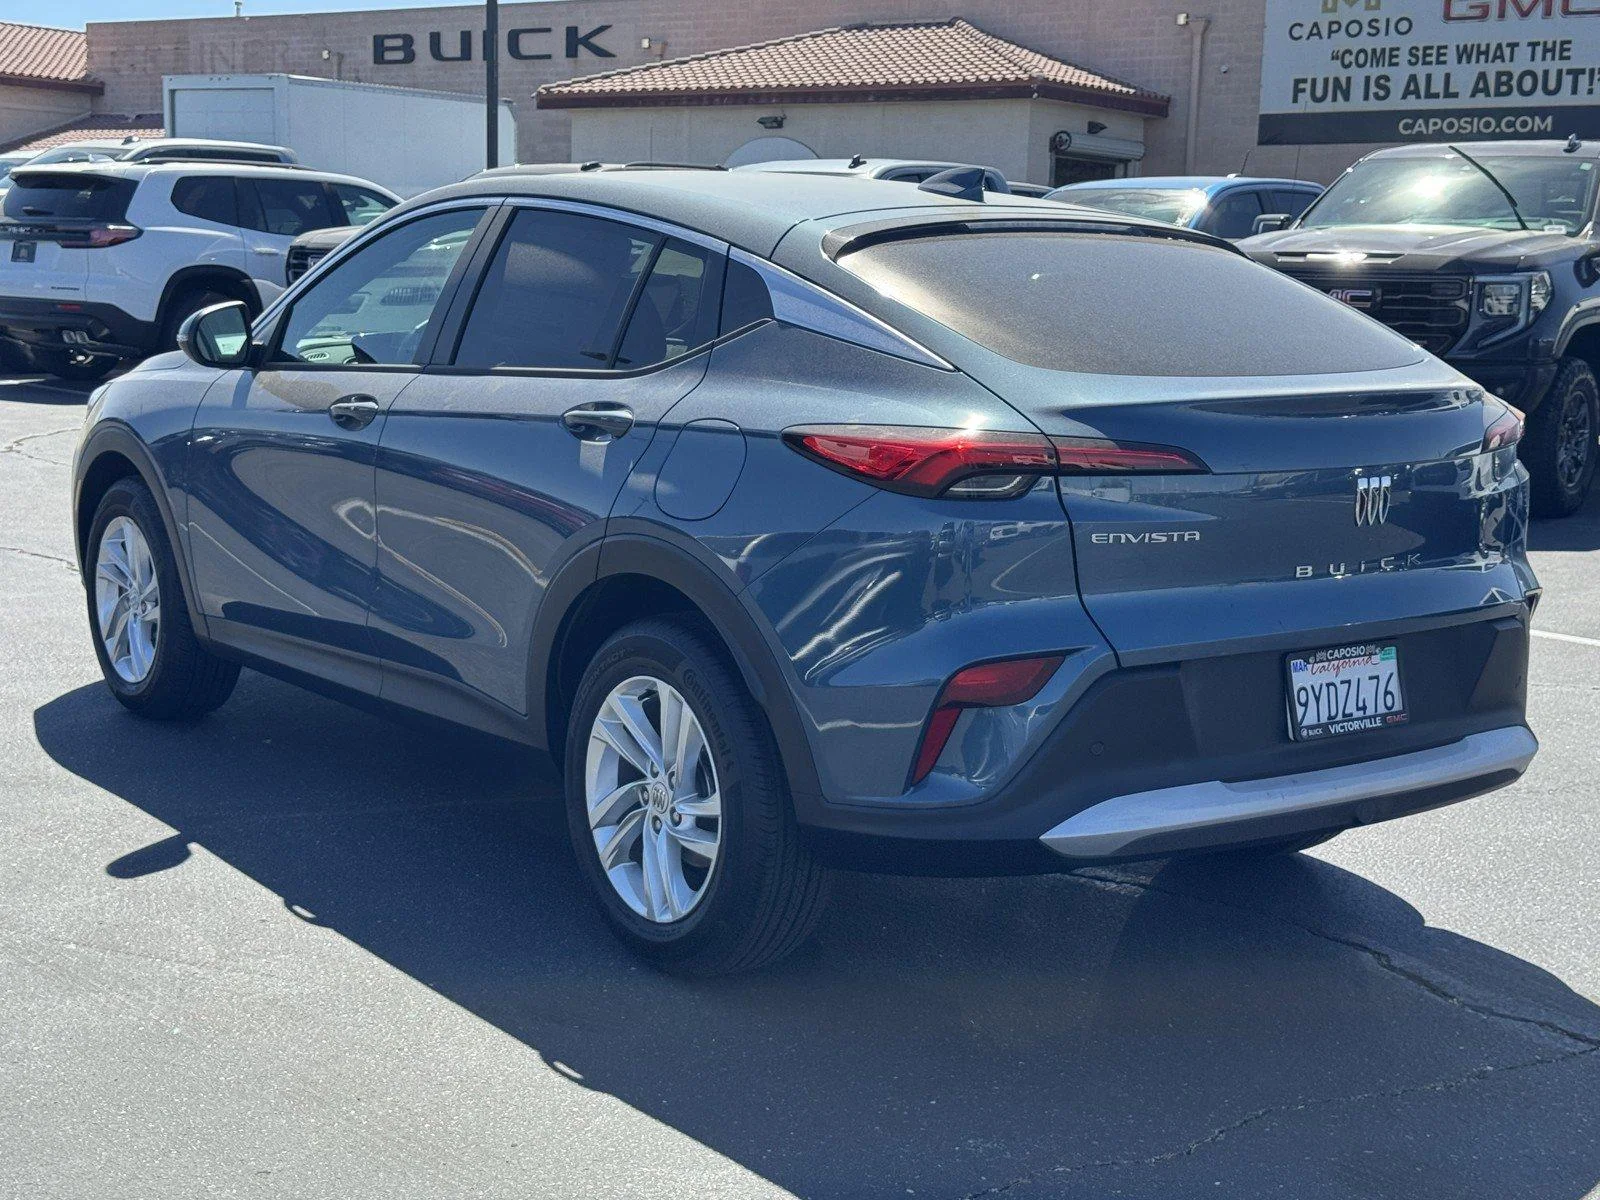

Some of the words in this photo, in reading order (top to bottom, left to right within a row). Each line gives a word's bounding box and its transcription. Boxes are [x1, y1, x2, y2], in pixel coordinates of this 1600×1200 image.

[1288, 16, 1413, 41] CAPOSIO
[1407, 44, 1448, 66] SEE
[1455, 41, 1519, 64] WHAT
[1527, 39, 1572, 62] THE
[1291, 75, 1352, 103] FUN
[1362, 73, 1391, 100] IS
[1401, 71, 1459, 100] ALL
[1469, 67, 1600, 99] ABOUT!
[1398, 115, 1553, 135] CAPOSIO.COM
[1091, 530, 1200, 544] ENVISTA
[1295, 553, 1422, 578] BUICK
[1327, 645, 1366, 660] CAPOSIO
[1296, 672, 1395, 727] 9YDZ476
[1328, 716, 1382, 734] VICTORVILLE
[1386, 713, 1408, 724] GMC
